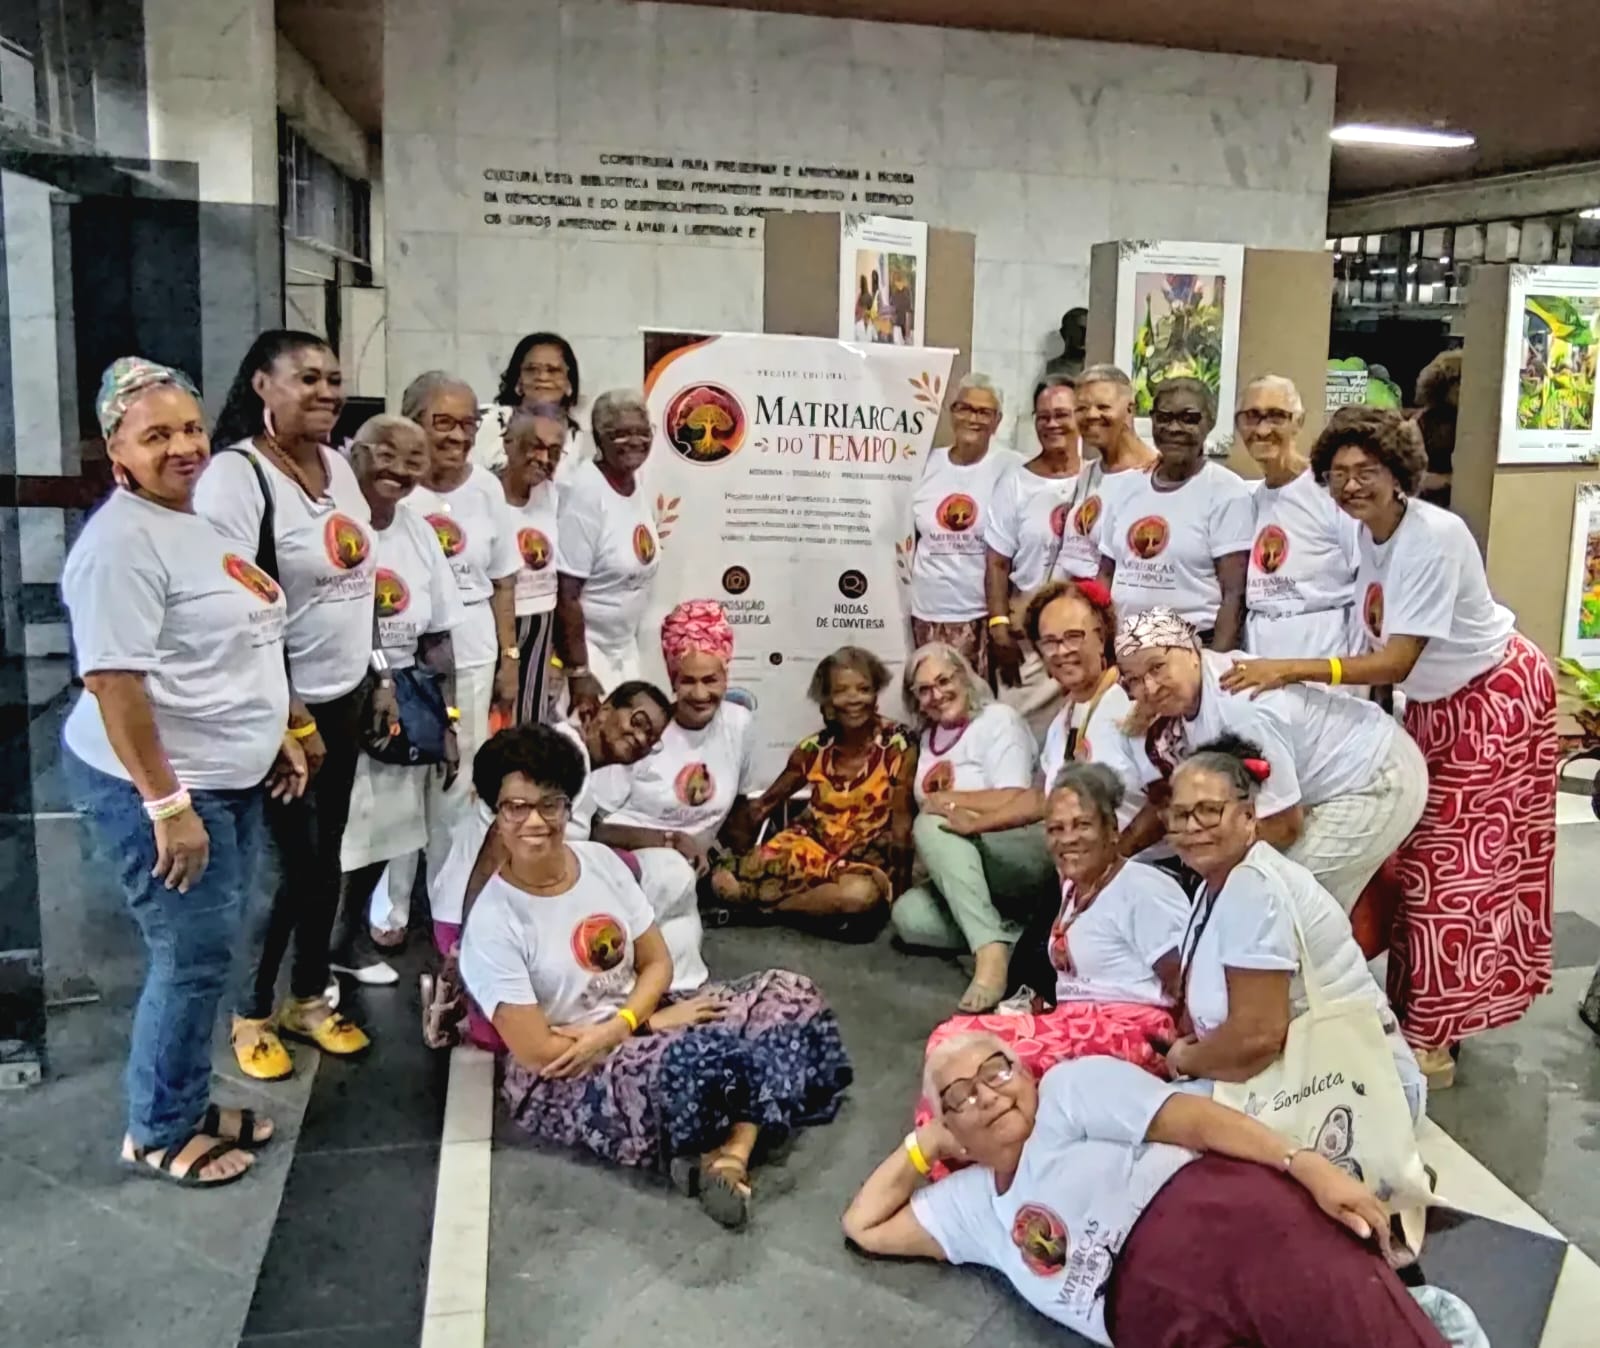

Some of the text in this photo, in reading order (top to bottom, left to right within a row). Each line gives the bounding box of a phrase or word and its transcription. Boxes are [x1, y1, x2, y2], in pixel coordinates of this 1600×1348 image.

[601, 198, 618, 209] DO
[755, 394, 925, 435] MATRIARCAS
[777, 433, 897, 464] DO TEMPO
[816, 616, 885, 629] DE CONVERSA
